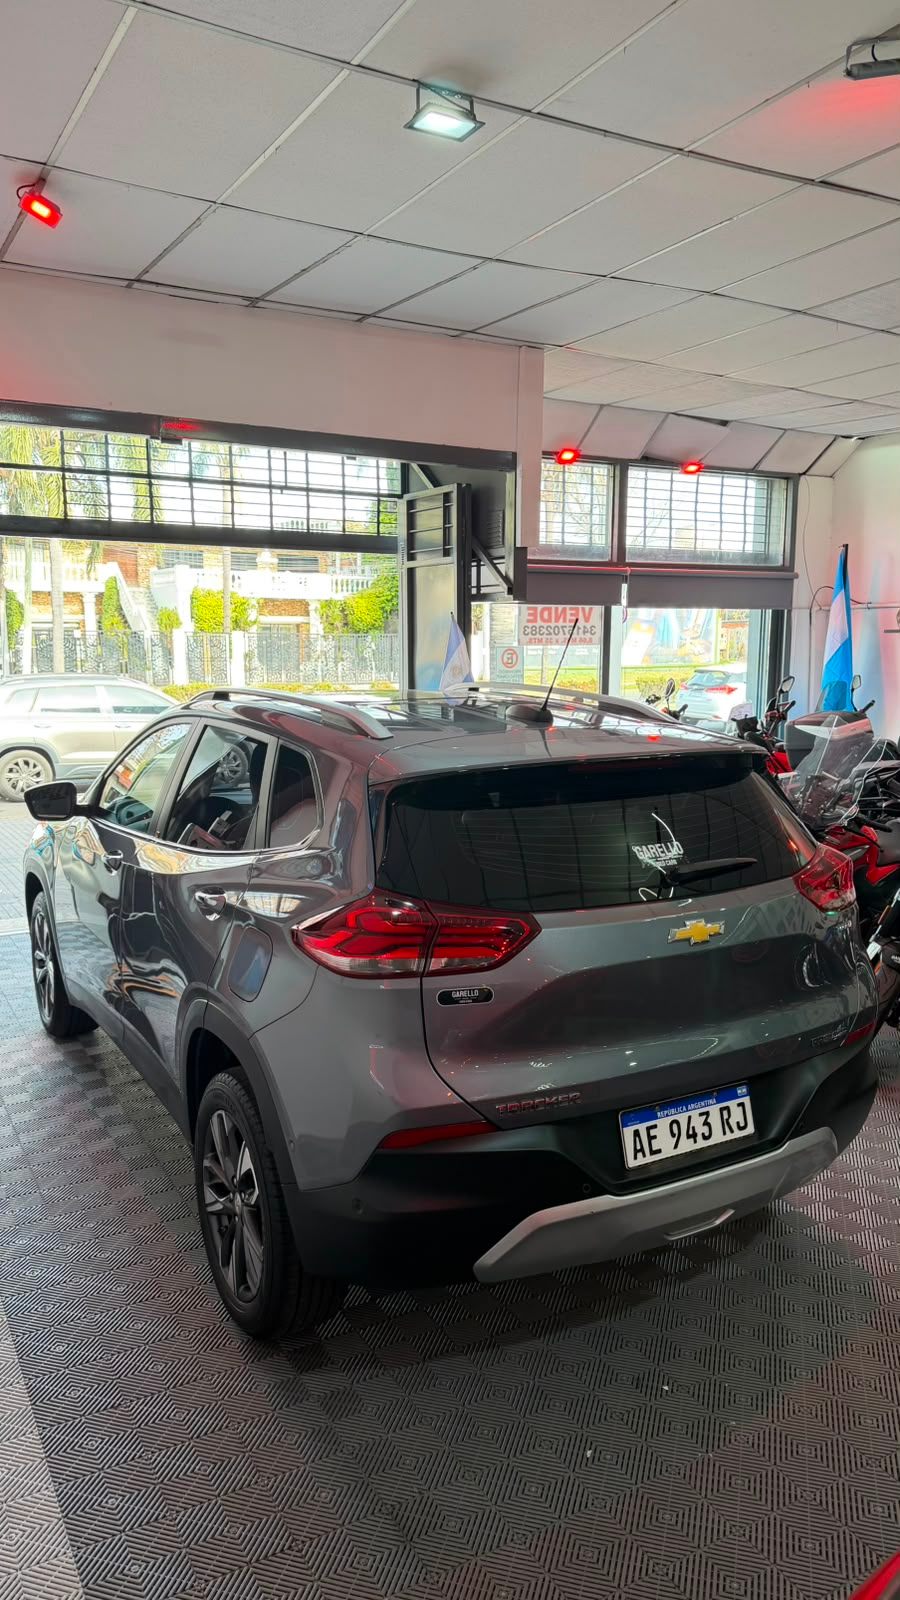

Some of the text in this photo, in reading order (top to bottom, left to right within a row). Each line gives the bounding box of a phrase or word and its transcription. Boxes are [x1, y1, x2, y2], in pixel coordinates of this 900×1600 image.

[633, 841, 684, 860] GARELLO
[451, 989, 479, 998] GARELLO
[687, 1098, 717, 1111] ARGENTINA
[633, 1101, 749, 1161] AE 943 RJ
